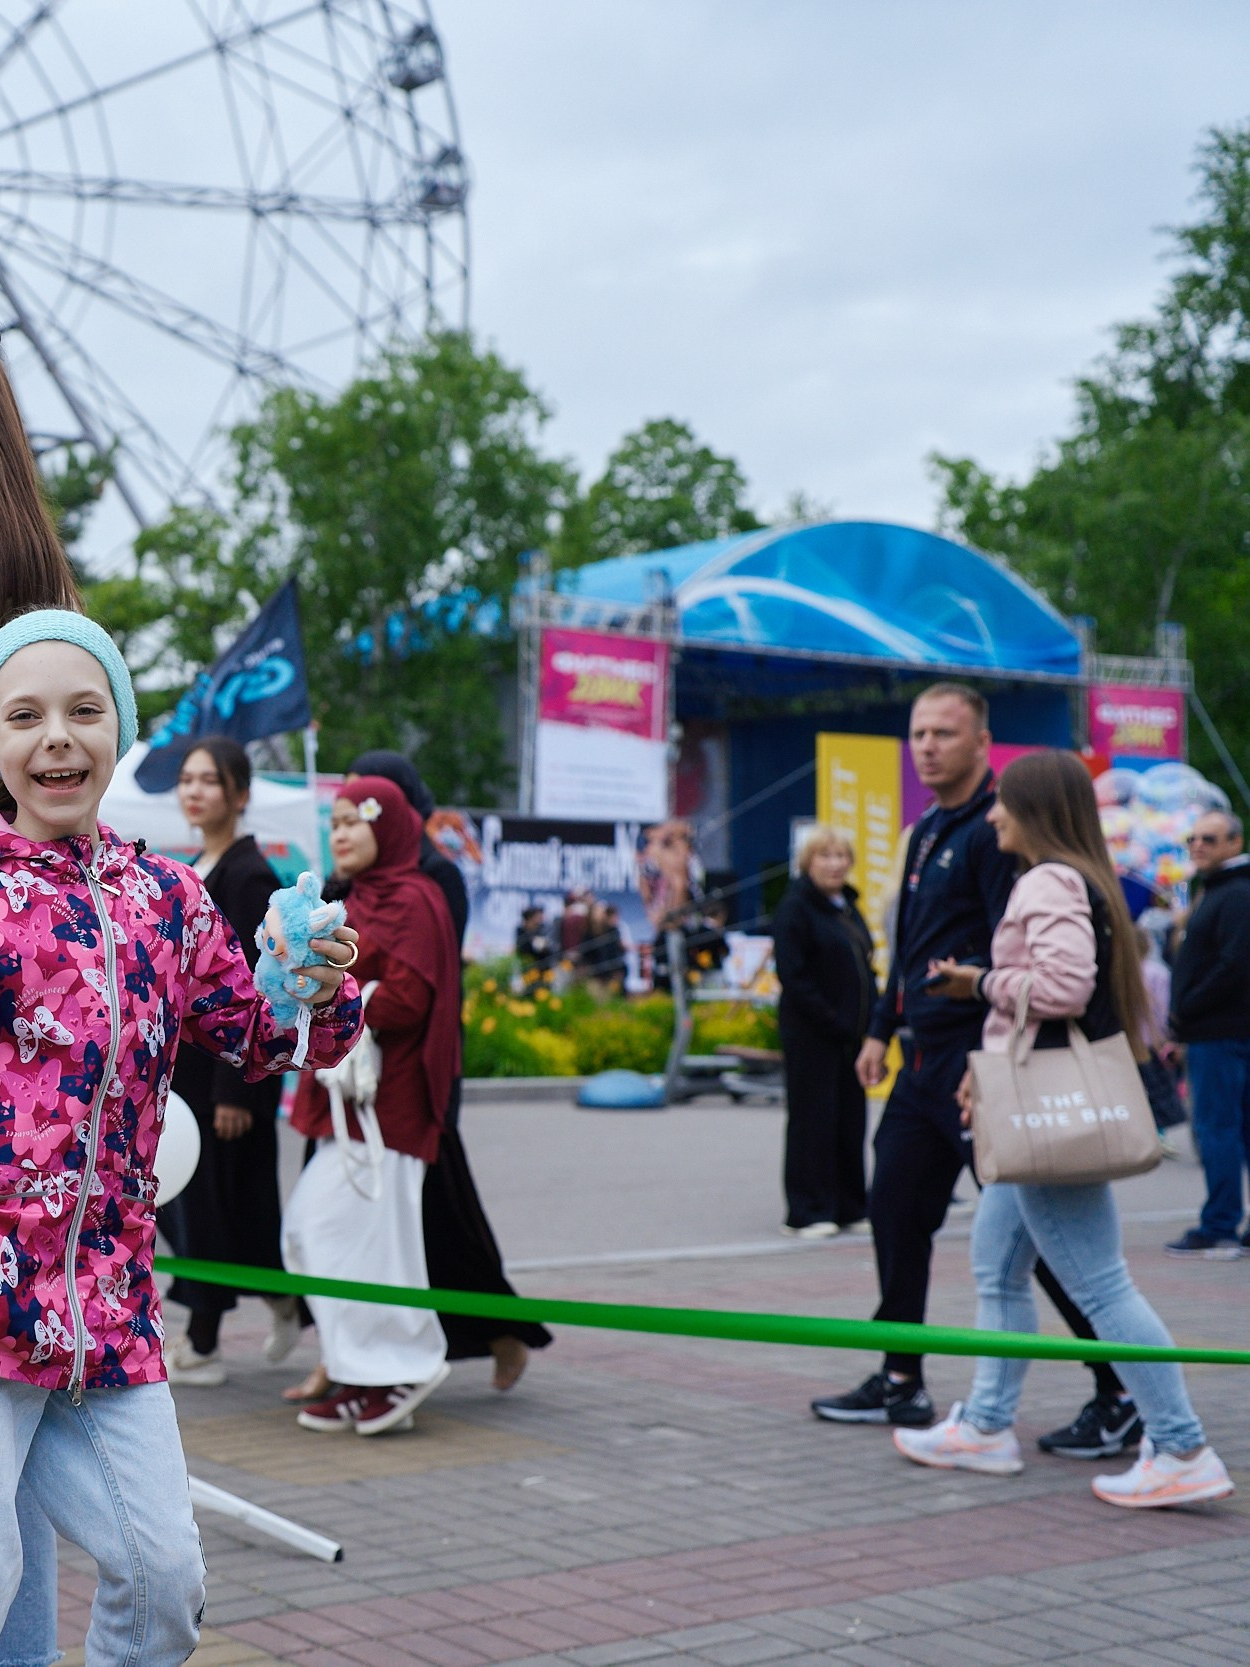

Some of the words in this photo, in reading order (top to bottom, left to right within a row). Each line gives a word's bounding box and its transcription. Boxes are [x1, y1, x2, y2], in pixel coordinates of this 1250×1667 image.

[1039, 1090, 1087, 1111] THE
[1010, 1112, 1071, 1130] TOTE
[1080, 1104, 1130, 1124] BAG
